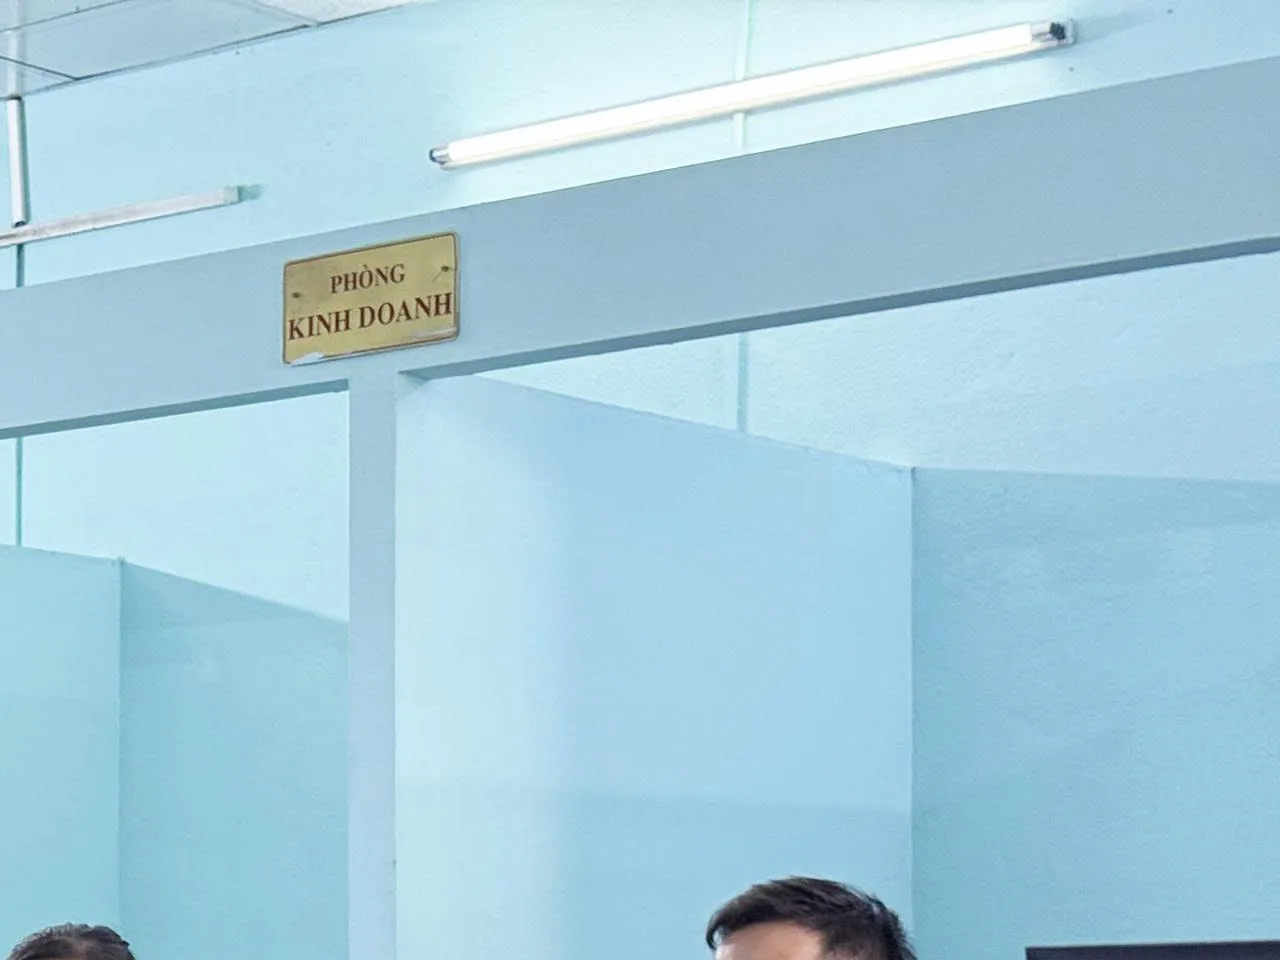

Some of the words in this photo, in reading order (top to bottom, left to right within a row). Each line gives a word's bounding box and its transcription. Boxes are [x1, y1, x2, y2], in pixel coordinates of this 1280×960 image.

[330, 264, 406, 295] PHÒNG
[287, 309, 352, 341] KINH
[358, 292, 453, 330] DOANH
